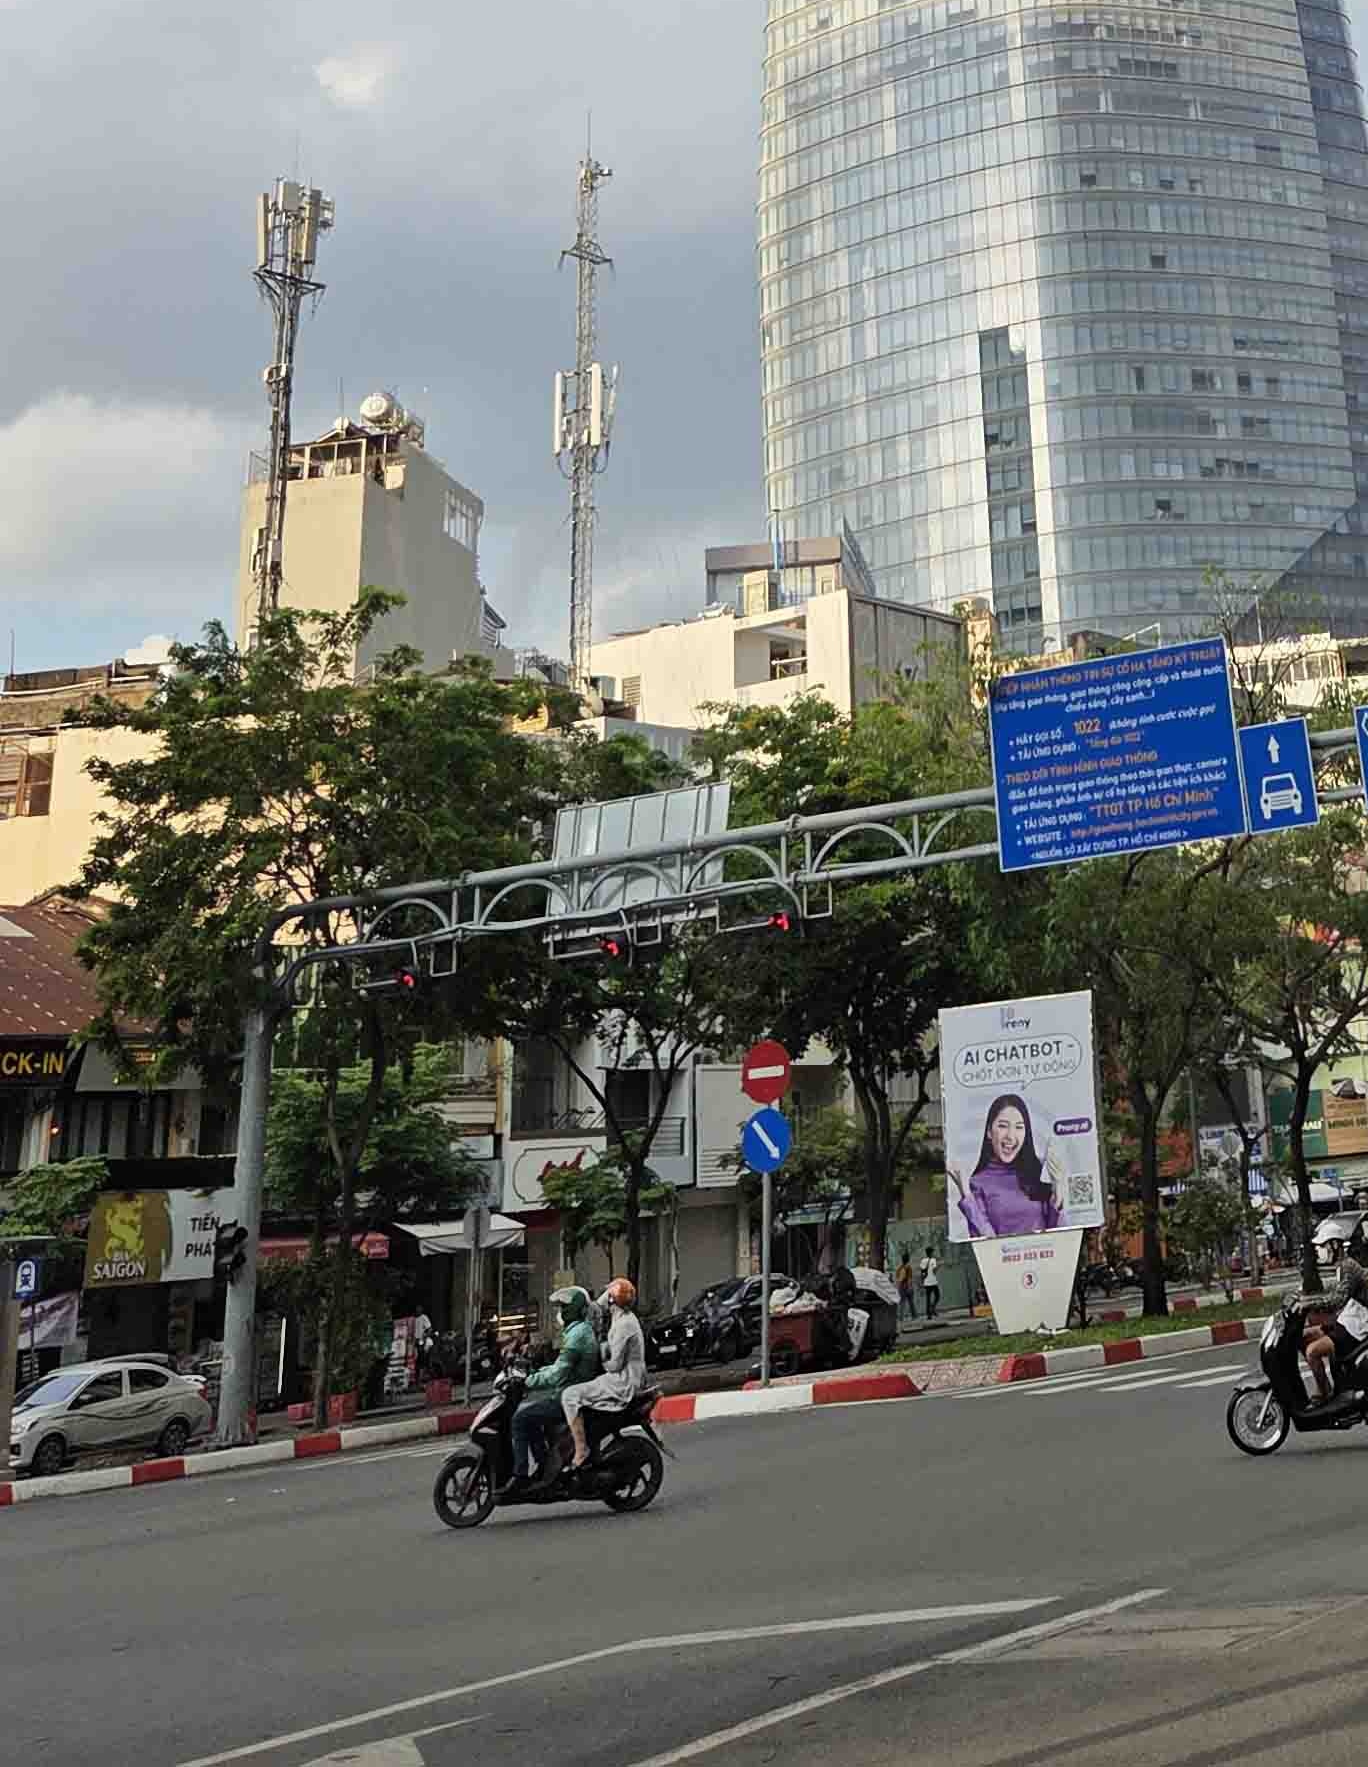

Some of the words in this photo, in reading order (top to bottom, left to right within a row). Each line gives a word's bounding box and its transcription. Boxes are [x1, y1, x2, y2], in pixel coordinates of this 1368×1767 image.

[1073, 716, 1102, 737] 1022
[964, 1050, 980, 1066] AI
[984, 1040, 1062, 1063] CHATBOT
[191, 1210, 220, 1232] TIẾN
[184, 1237, 216, 1258] PHÁ
[94, 1261, 146, 1279] SAIGON
